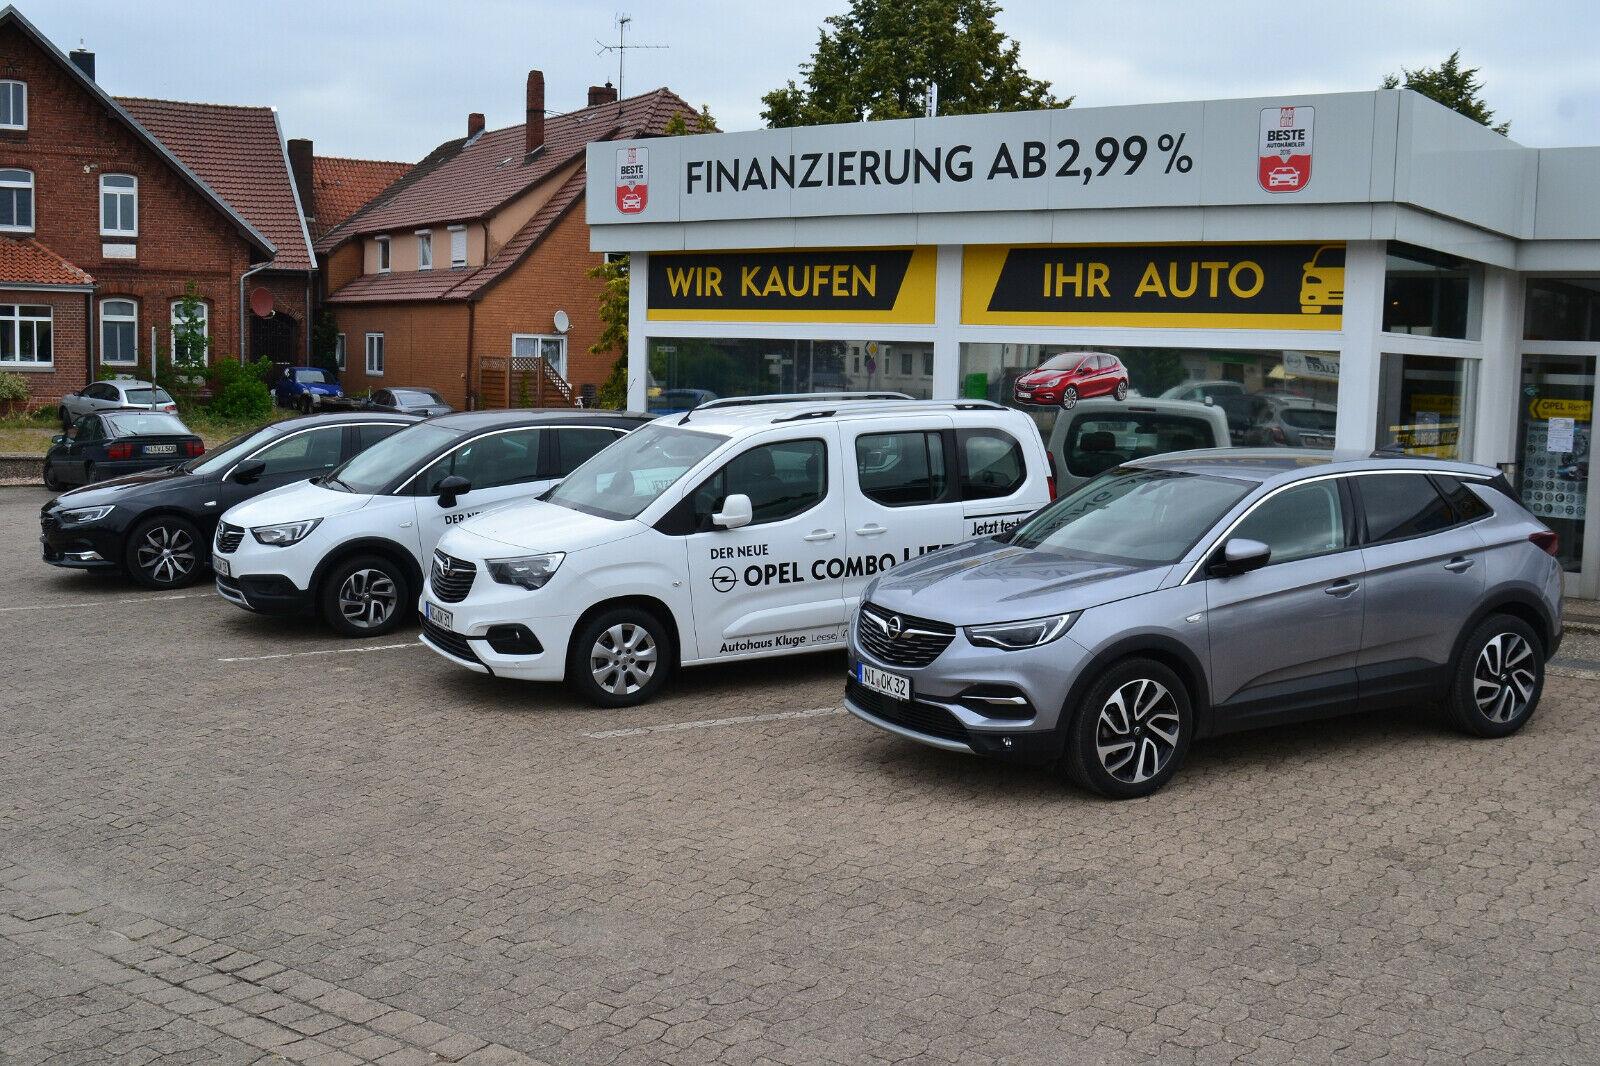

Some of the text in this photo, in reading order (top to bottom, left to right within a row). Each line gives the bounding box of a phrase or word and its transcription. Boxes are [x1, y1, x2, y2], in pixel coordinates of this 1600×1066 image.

[1267, 129, 1305, 141] BESTE
[620, 165, 644, 174] BESTE
[687, 132, 1193, 194] FINANZIERUNG AB 2,99 %
[666, 264, 878, 298] WIR KAUFEN
[1043, 261, 1265, 298] IHR AUTO
[1542, 401, 1565, 410] OPEL
[445, 514, 465, 525] DER
[971, 520, 998, 536] Jetzt
[710, 544, 769, 560] DER NEUE
[743, 553, 896, 586] OPEL COMBO
[719, 635, 807, 653] Autohaus Kluge
[864, 667, 875, 685] NI
[895, 678, 906, 696] 32
